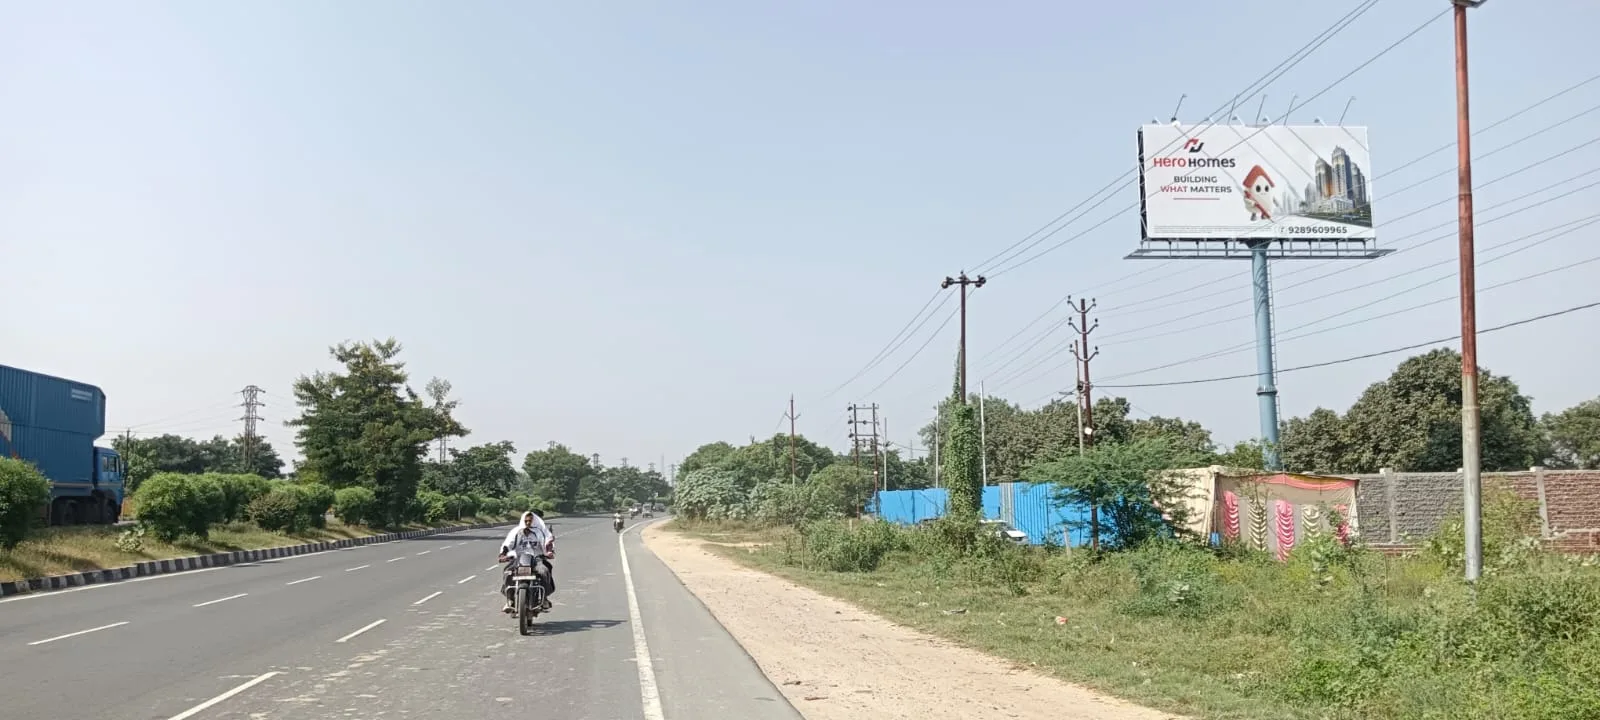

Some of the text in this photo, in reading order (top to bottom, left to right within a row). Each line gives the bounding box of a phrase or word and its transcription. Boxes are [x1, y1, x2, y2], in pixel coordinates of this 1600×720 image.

[1173, 175, 1218, 183] BUILDING
[1160, 185, 1233, 193] WHAT MATTERS
[1288, 226, 1348, 234] 9289609965
